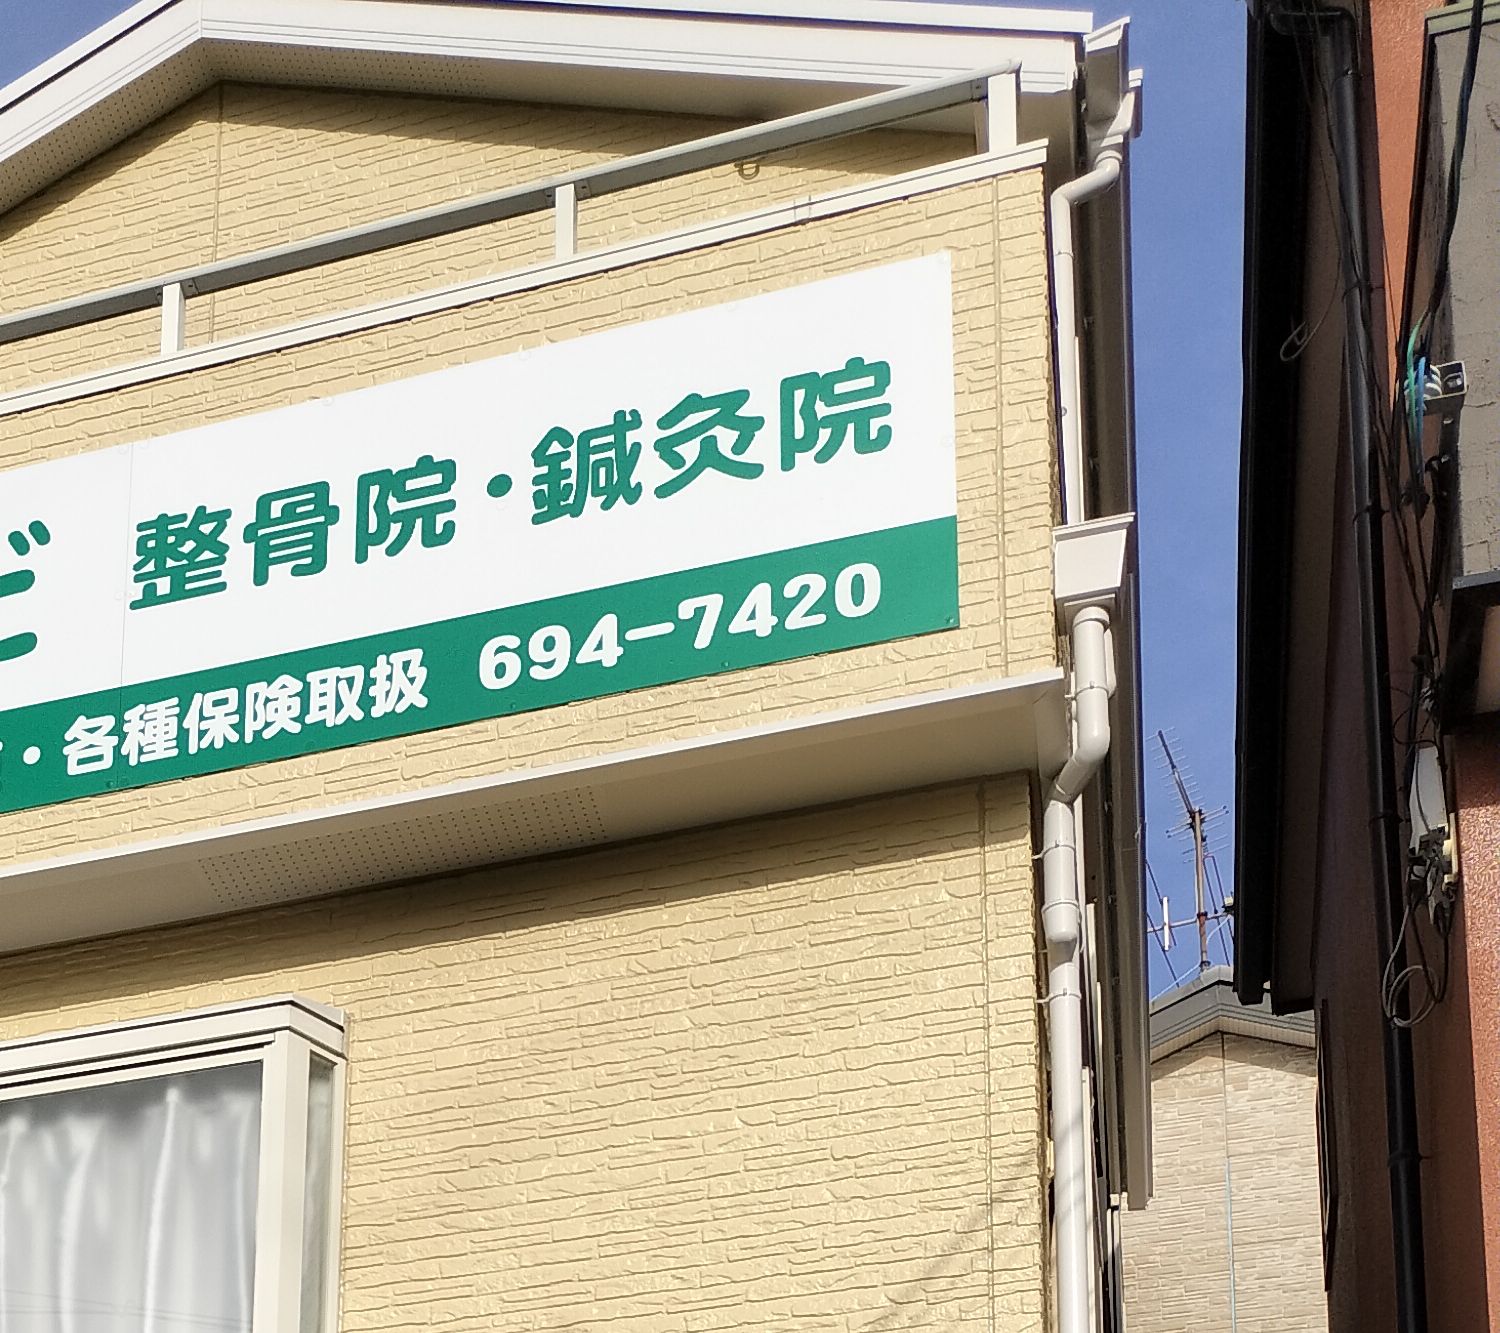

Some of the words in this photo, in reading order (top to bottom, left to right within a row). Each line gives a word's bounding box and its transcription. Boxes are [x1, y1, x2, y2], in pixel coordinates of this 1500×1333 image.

[129, 356, 894, 611] 整骨院・鍼灸院
[478, 561, 883, 691] 694-7420
